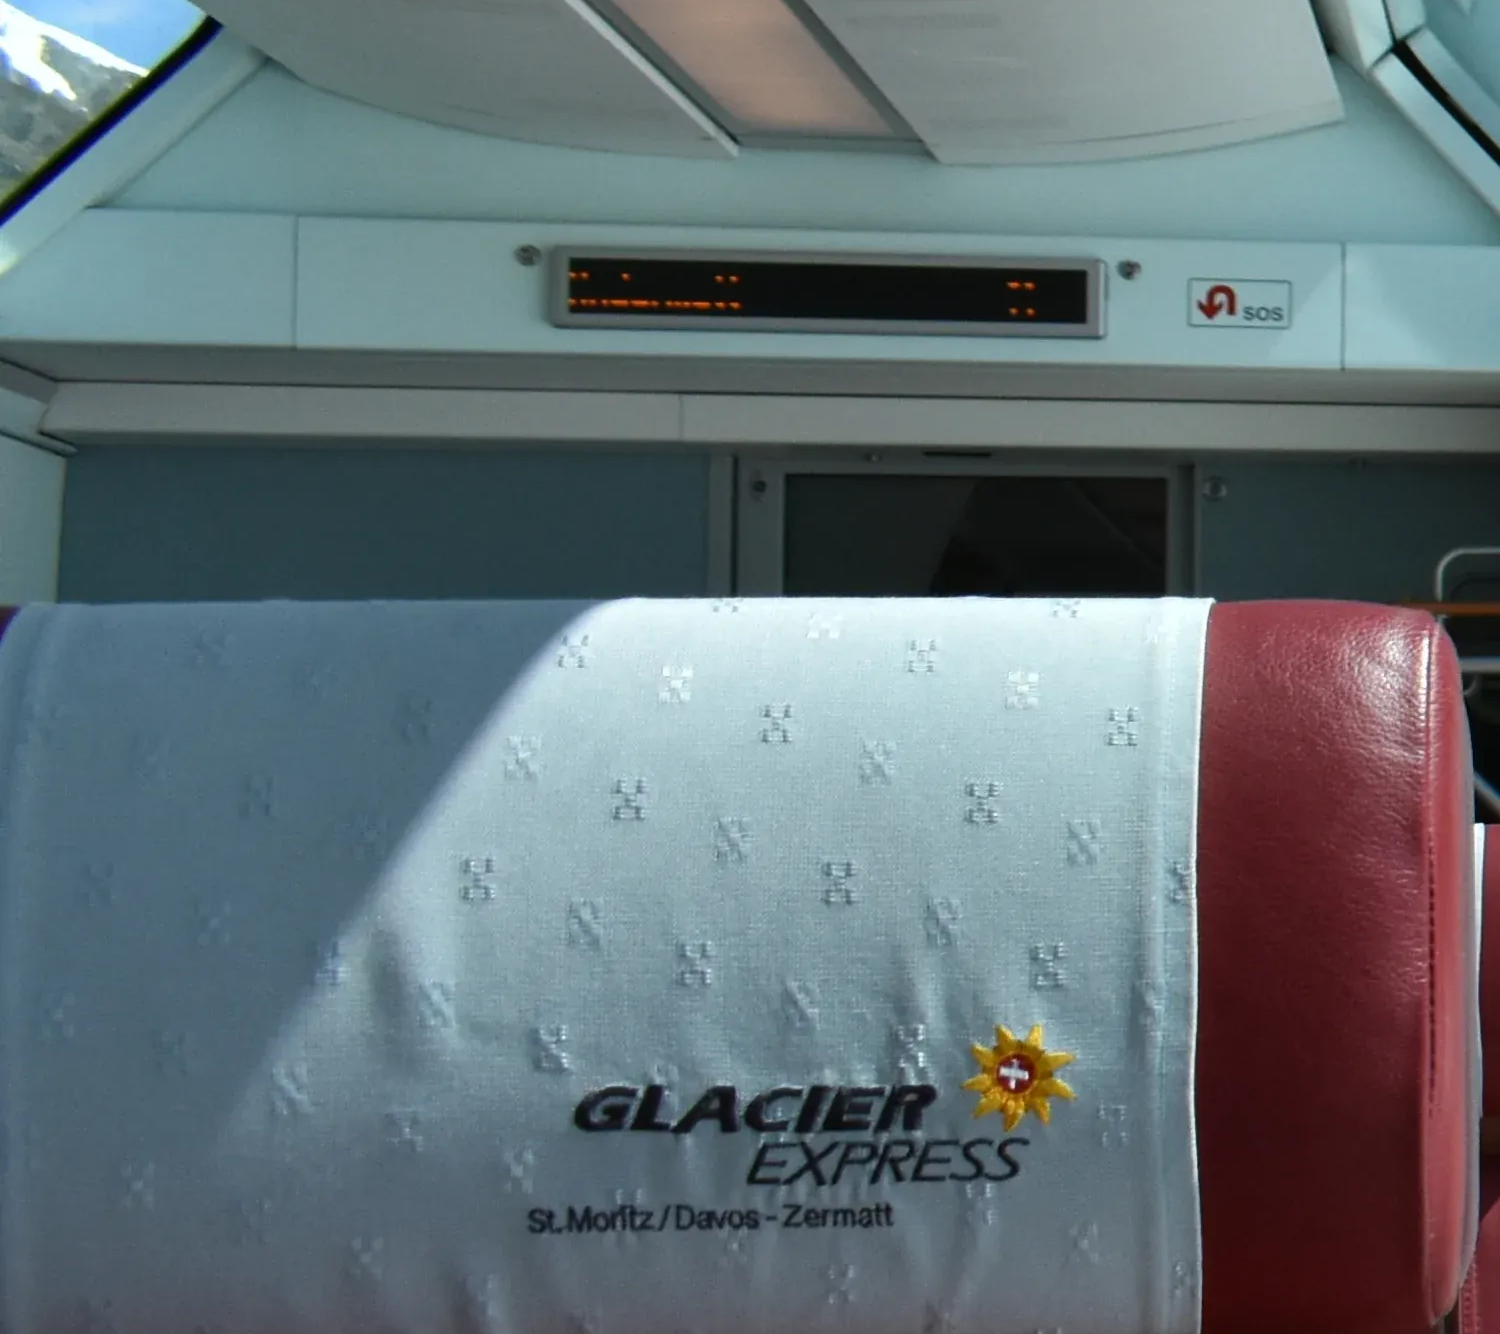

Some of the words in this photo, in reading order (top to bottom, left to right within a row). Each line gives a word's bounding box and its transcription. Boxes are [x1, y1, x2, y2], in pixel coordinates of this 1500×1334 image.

[1242, 305, 1285, 323] SOS
[573, 1083, 938, 1134] GLACIER
[745, 1136, 1031, 1186] EXPRESS
